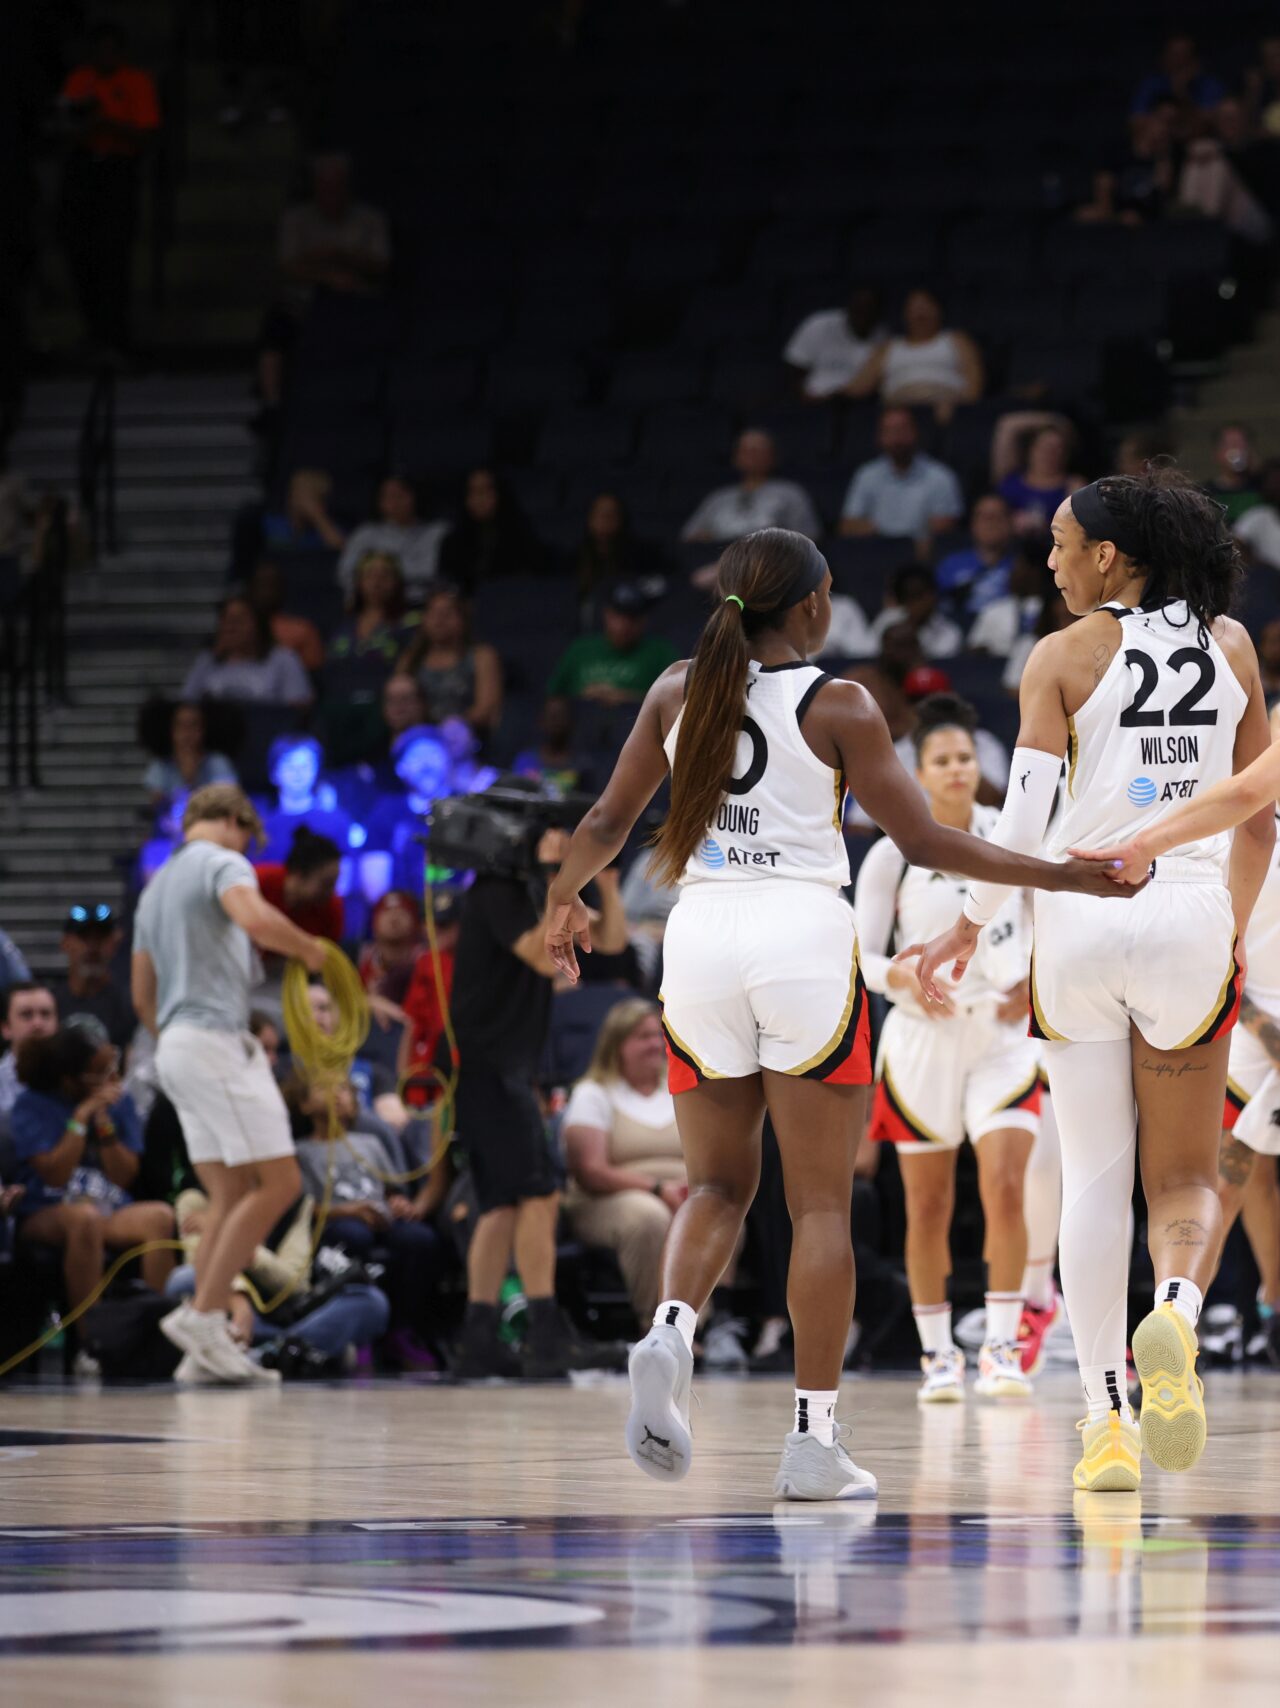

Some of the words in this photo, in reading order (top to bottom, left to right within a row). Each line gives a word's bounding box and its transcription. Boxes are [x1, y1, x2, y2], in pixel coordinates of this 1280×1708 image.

[1119, 647, 1218, 728] 22
[1140, 735, 1199, 765] WILSON
[1160, 779, 1199, 802] AT&T
[707, 803, 760, 836] OUNG
[727, 846, 781, 868] AT&T
